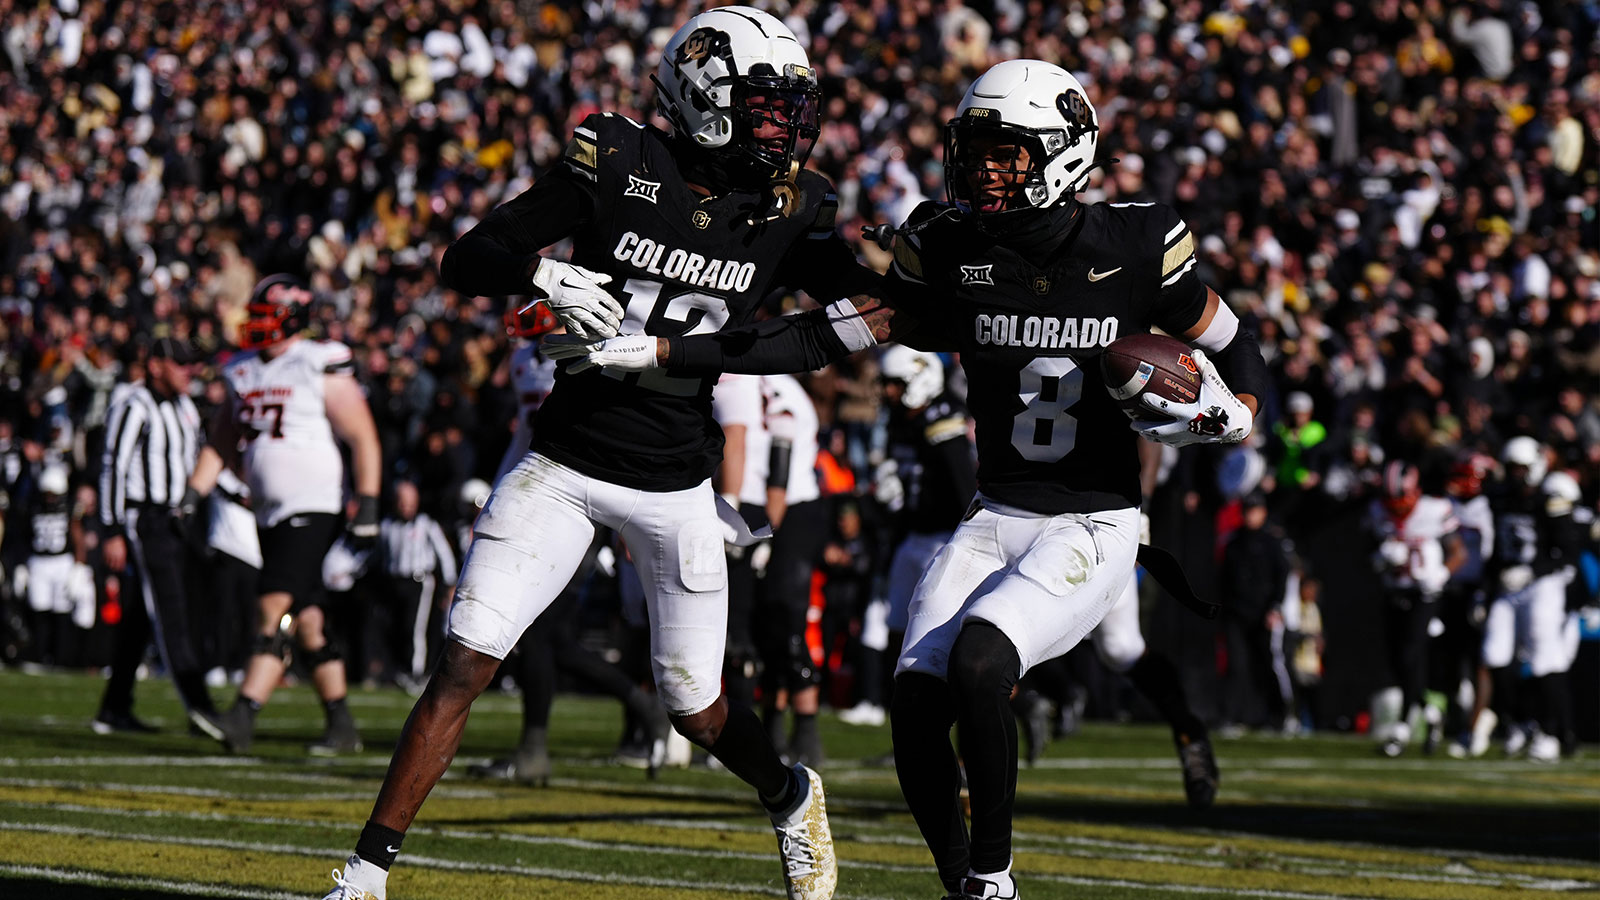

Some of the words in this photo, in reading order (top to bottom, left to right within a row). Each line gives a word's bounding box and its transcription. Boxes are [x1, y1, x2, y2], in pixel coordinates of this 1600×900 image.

[613, 231, 756, 293] COLORADO
[975, 314, 1119, 348] COLORADO
[1010, 355, 1085, 463] 8
